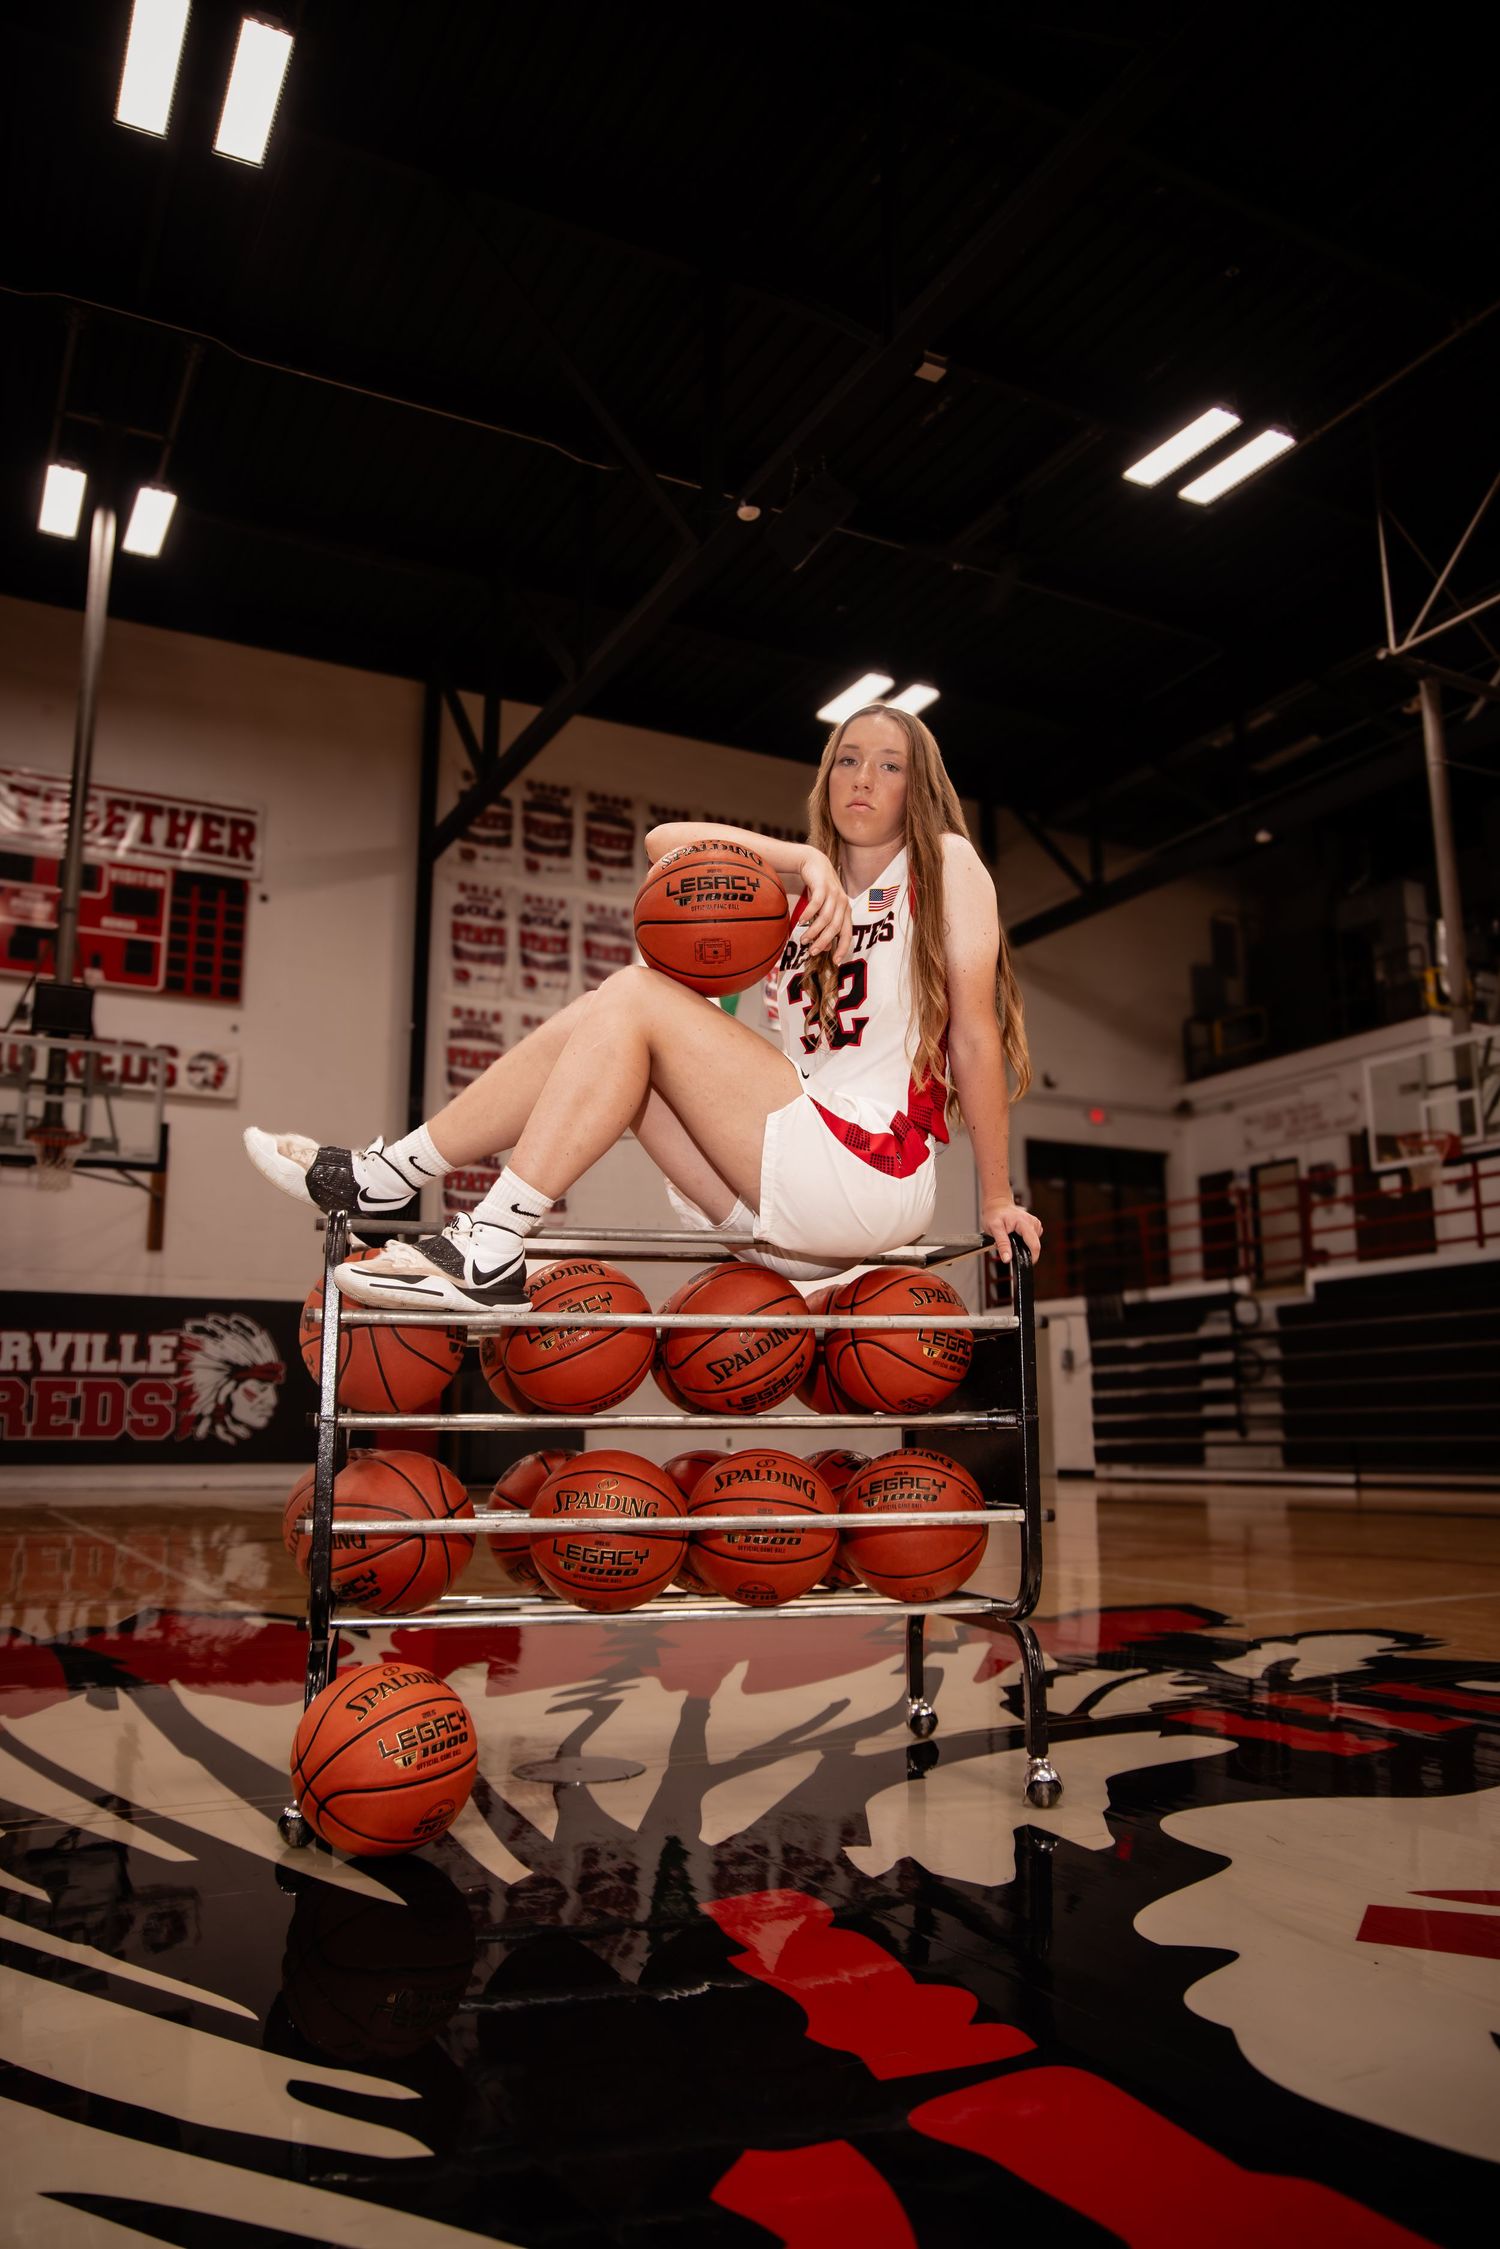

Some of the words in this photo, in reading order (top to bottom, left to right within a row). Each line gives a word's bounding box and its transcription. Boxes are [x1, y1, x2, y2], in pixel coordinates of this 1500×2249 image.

[666, 876, 760, 897] LEGACY
[696, 892, 754, 903] 1000
[779, 910, 895, 972] RETES
[786, 958, 869, 1055] 32
[525, 1263, 607, 1298] ALDING
[0, 1331, 178, 1374] RVILLE
[917, 1327, 972, 1356] LEGAC
[922, 1345, 941, 1358] TF
[725, 1354, 805, 1408] LEGACY
[714, 1468, 817, 1503] SPALDING
[857, 1476, 947, 1499] LEGACY
[552, 1490, 659, 1518] SPALDING
[552, 1537, 650, 1566] LEGACY
[743, 1534, 802, 1546] 1000
[579, 1565, 640, 1578] 1000
[345, 1671, 453, 1722] SPALDIN
[377, 1708, 468, 1760] LEGACY
[394, 1751, 418, 1769] TF
[422, 1731, 468, 1758] 1000
